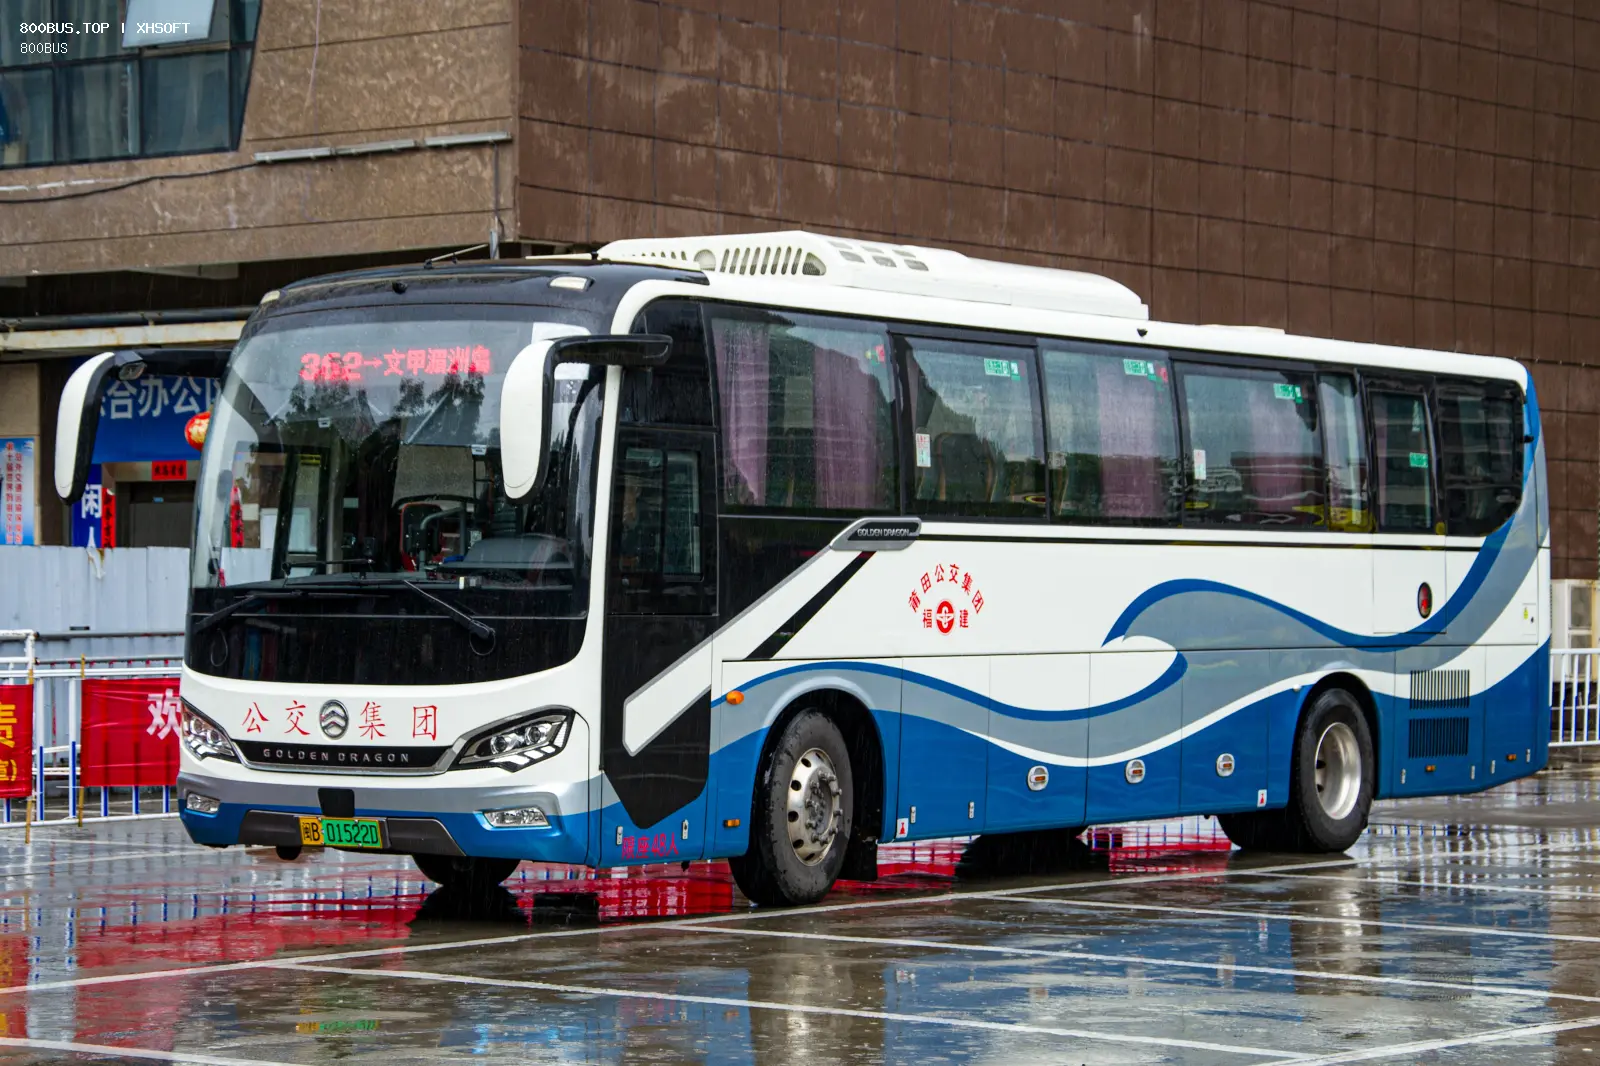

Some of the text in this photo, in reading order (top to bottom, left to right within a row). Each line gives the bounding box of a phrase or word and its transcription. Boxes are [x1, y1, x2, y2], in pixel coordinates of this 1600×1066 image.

[100, 376, 221, 419] 合办公
[857, 528, 883, 537] GOLDEN
[263, 748, 410, 764] GOLDEN DRAGON
